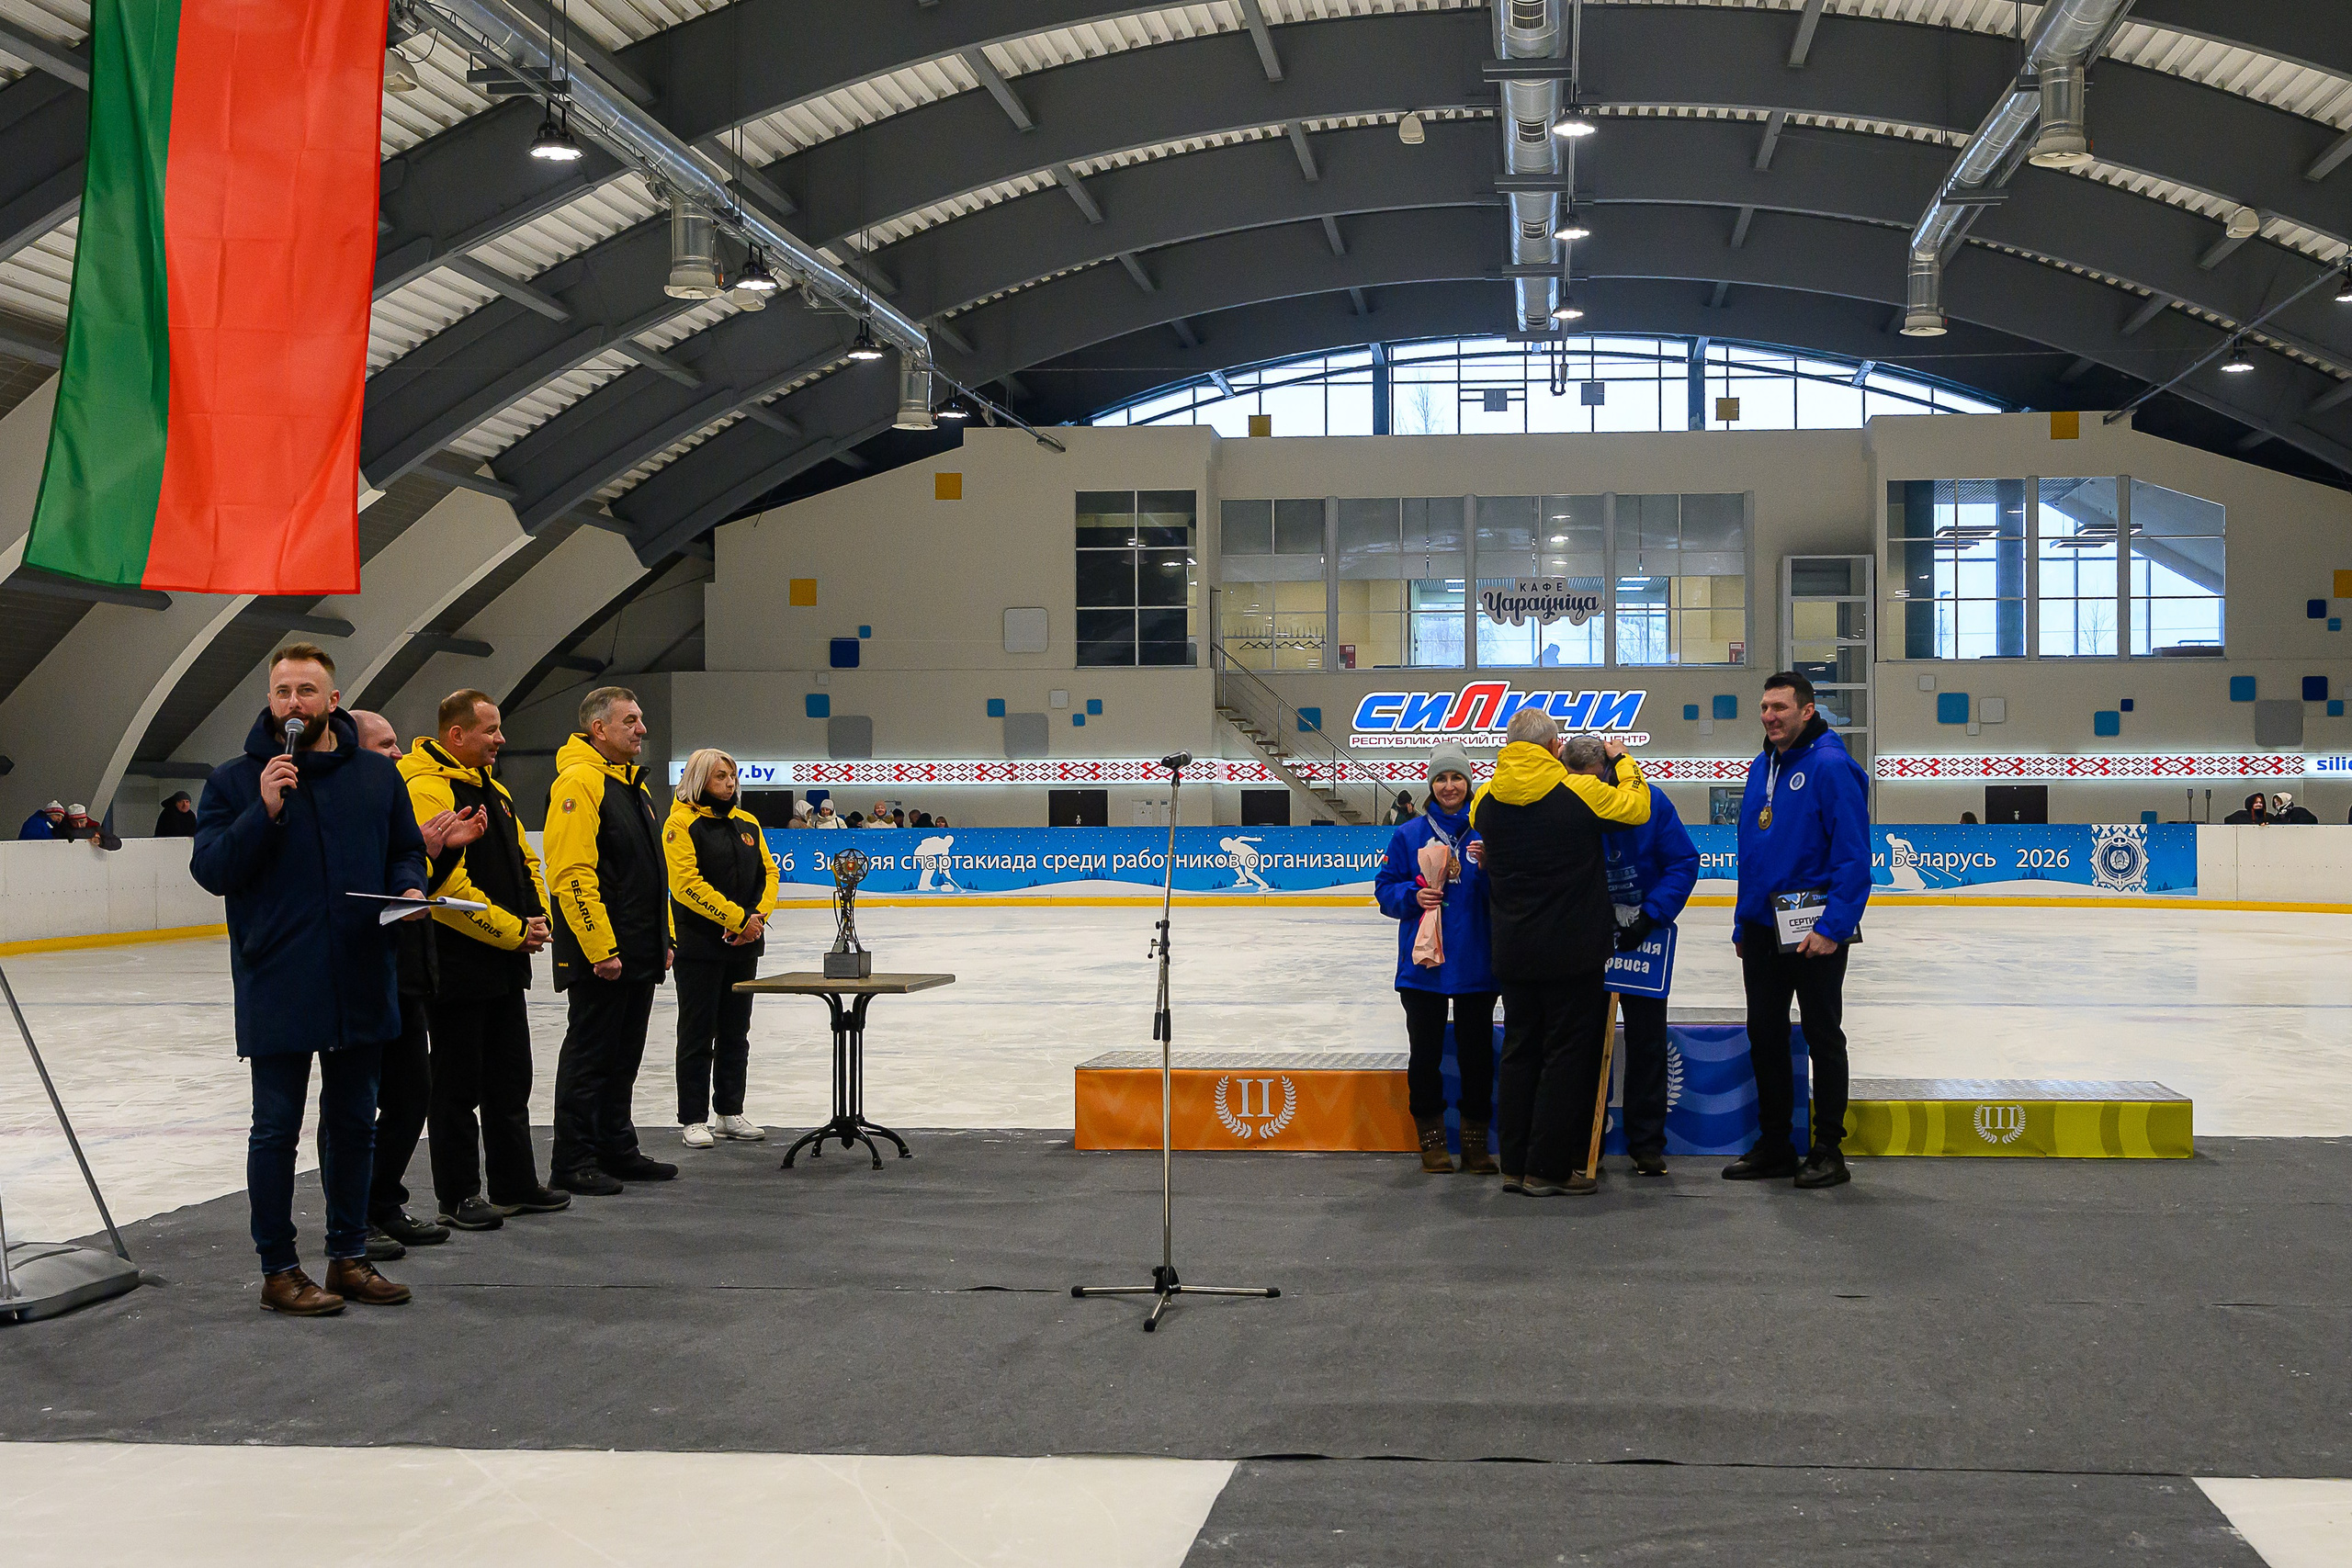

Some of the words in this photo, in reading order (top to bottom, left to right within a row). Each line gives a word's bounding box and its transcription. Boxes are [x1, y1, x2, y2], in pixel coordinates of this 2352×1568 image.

[1520, 582, 1563, 592] КАФЕ
[771, 852, 796, 872] 26
[813, 852, 895, 871] Зияя
[900, 855, 1037, 873] спартакиада
[1043, 854, 1107, 874] среди
[1245, 848, 1385, 874] организаций
[1891, 847, 1997, 874] Беларусь
[2016, 848, 2071, 868] 2026
[571, 879, 595, 932] BELARUS
[684, 887, 729, 921] BELARUS
[460, 909, 503, 938] ELARUS
[1789, 916, 1820, 927] СЕРТИ
[1604, 956, 1650, 975] рвиса
[1236, 1078, 1275, 1117] II
[1982, 1106, 2018, 1130] III
